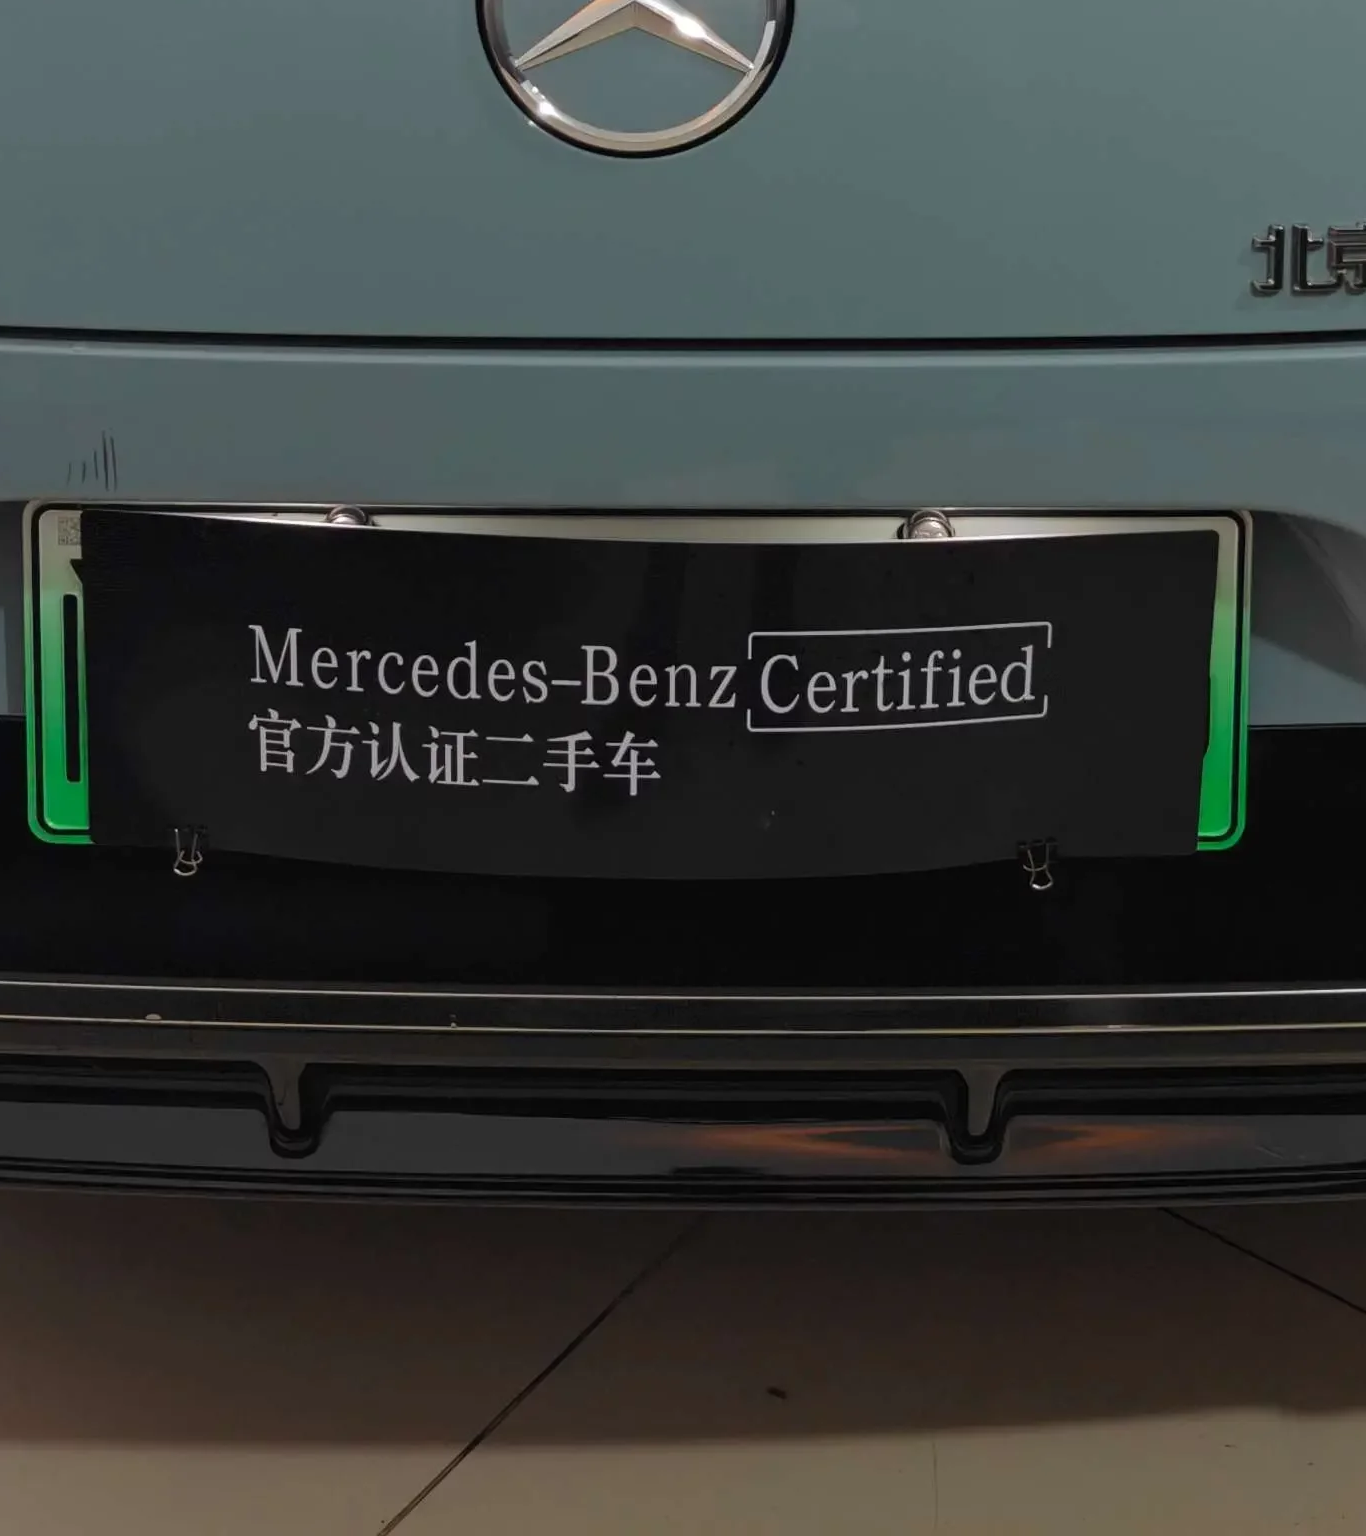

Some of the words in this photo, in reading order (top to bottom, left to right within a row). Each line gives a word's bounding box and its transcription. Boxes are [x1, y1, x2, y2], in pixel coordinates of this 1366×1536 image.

[248, 624, 739, 710] Mercedes-Benz
[759, 645, 1037, 715] Certified
[247, 708, 663, 797] 官方认证二手车
